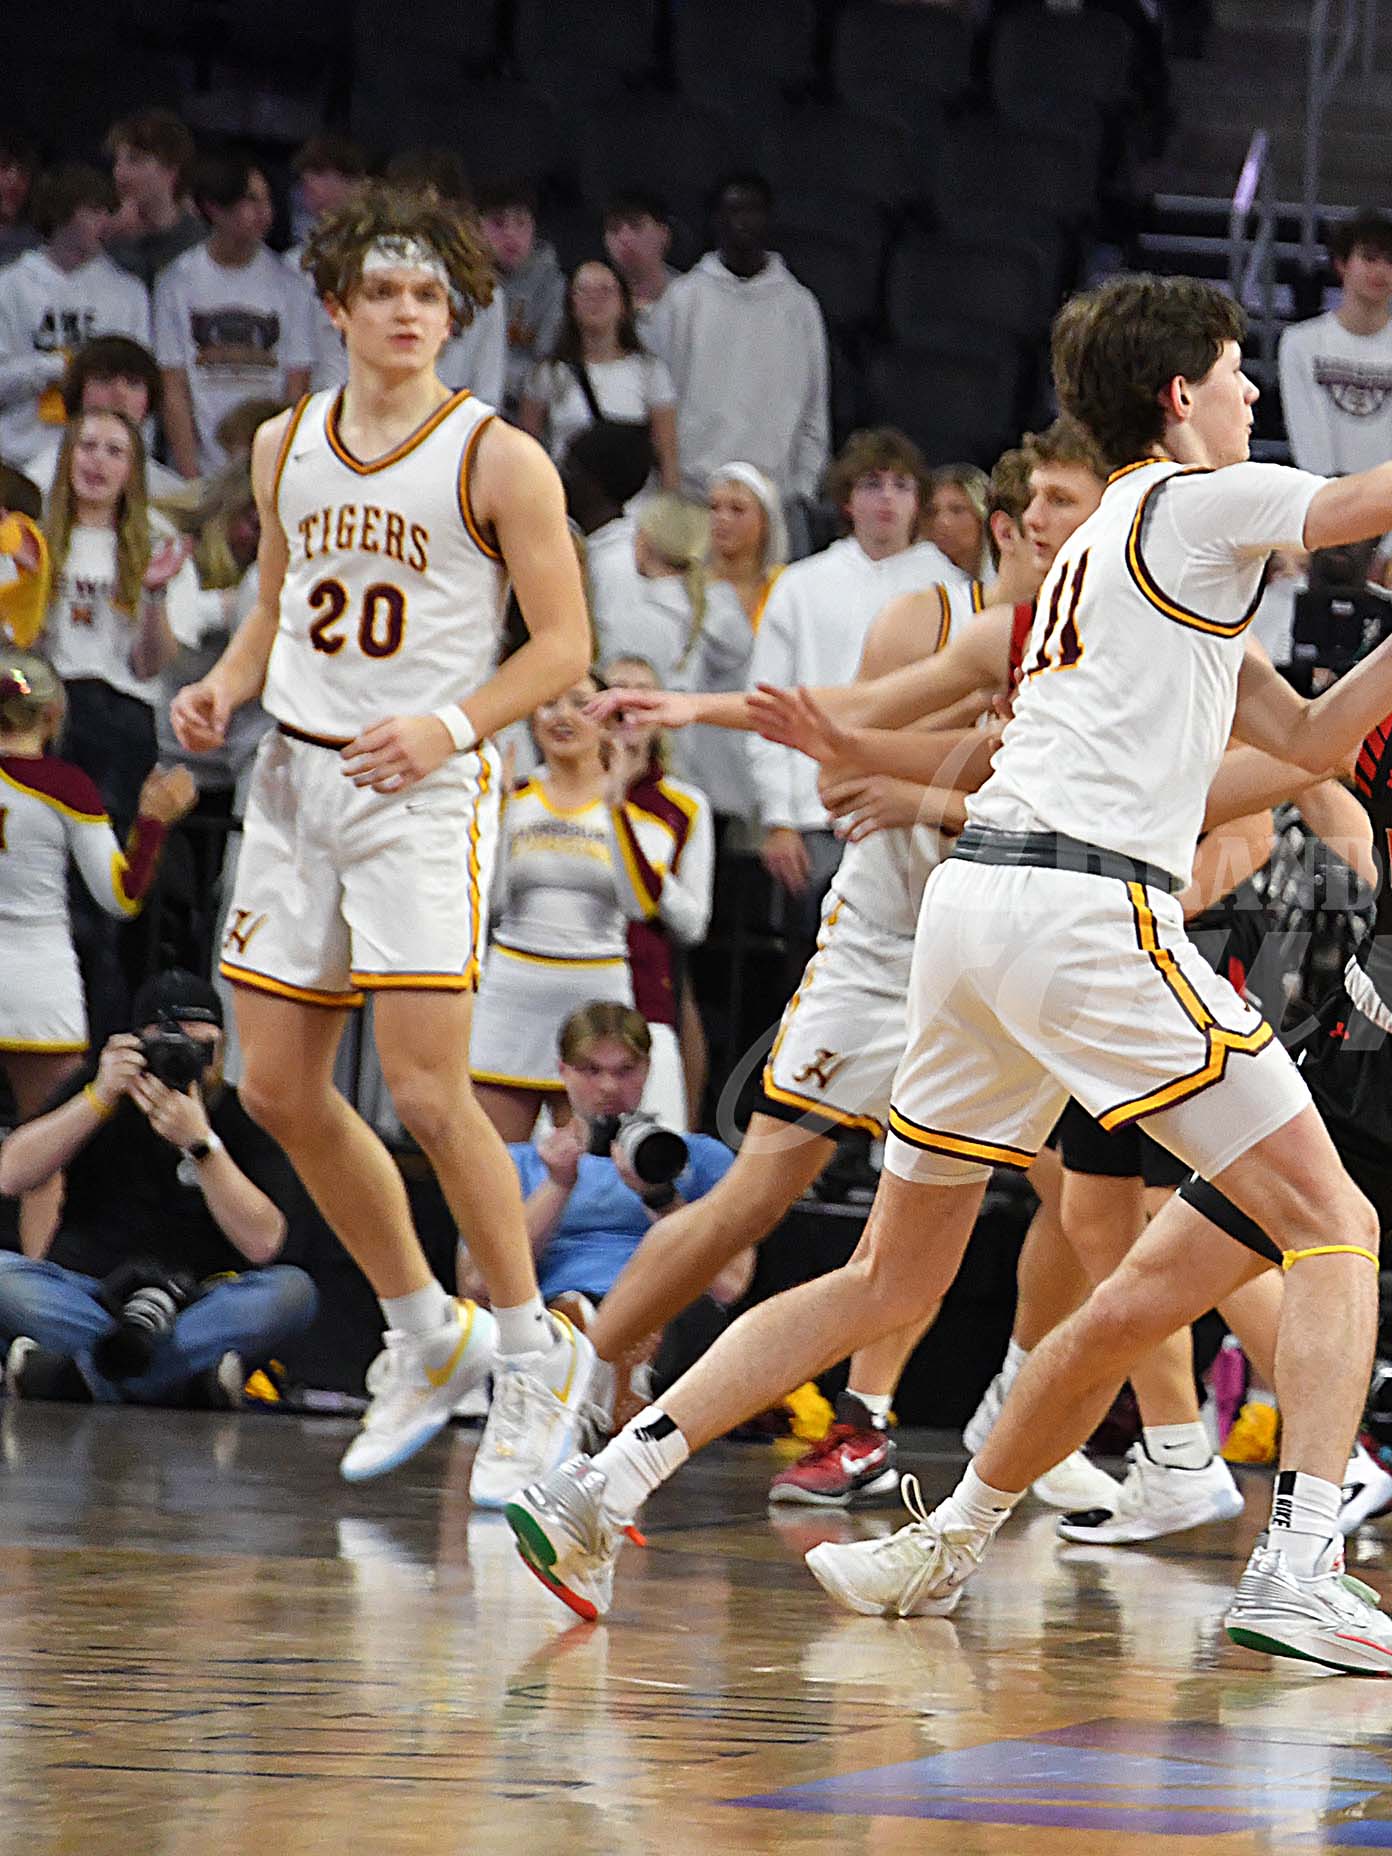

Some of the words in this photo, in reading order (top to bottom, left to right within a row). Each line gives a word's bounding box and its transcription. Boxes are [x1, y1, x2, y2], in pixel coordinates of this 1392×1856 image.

[298, 504, 430, 574] TIGERS
[307, 578, 408, 660] 20
[1271, 1496, 1293, 1529] NIKE
